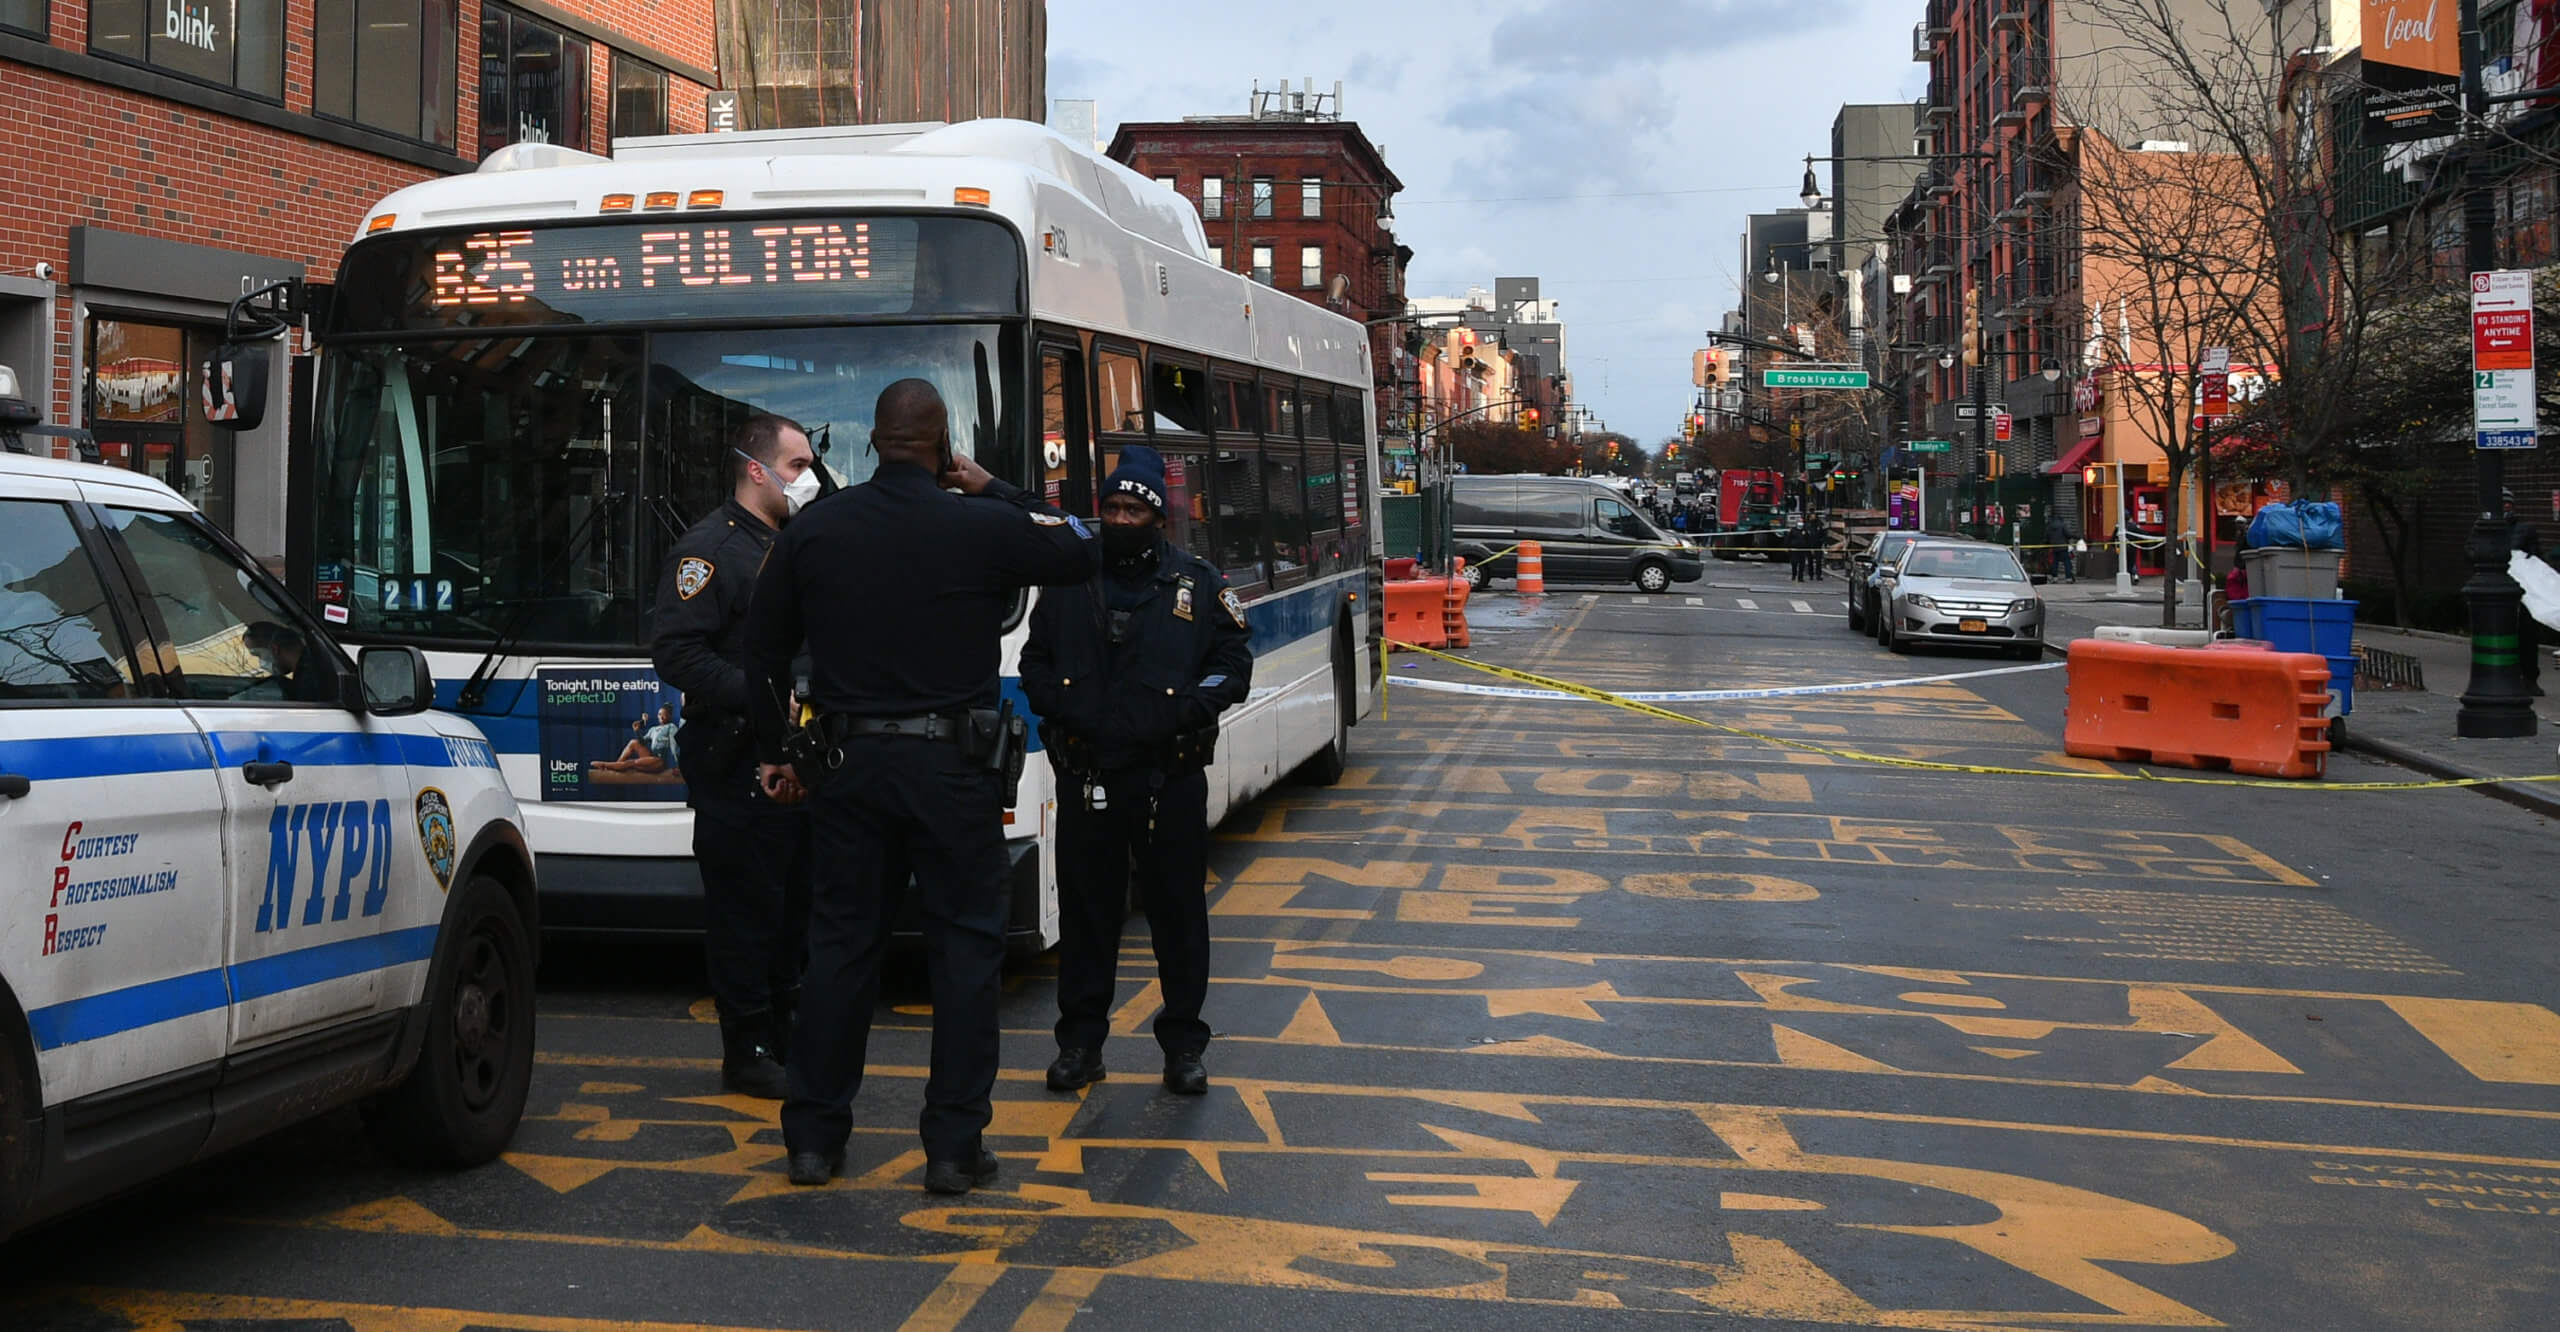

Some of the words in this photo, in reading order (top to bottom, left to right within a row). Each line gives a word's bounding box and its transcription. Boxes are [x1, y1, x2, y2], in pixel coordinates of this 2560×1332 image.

[166, 0, 216, 52] blink
[2384, 0, 2438, 49] local
[433, 230, 534, 304] B25
[641, 223, 870, 287] FULTON
[2478, 317, 2488, 325] NO
[2491, 315, 2527, 325] STANDING
[2484, 328, 2521, 336] ANYTIME
[1777, 373, 1836, 386] Brooklyn
[1838, 375, 1856, 384] Av
[2479, 373, 2490, 388] 2
[2485, 436, 2521, 446] 338543
[1118, 480, 1163, 508] NYPD
[545, 679, 589, 693] Tonight,
[591, 680, 602, 690] I'll
[604, 680, 620, 691] be
[622, 679, 660, 693] eating
[547, 695, 554, 703] a
[557, 692, 600, 705] perfect
[601, 692, 616, 703] 10
[550, 760, 578, 771] Uber
[551, 772, 578, 783] Eats
[61, 821, 139, 862] COURTESY
[256, 798, 392, 933] NYPD
[50, 866, 177, 908] PROFESSIONALISM
[42, 914, 107, 956] RESPECT
